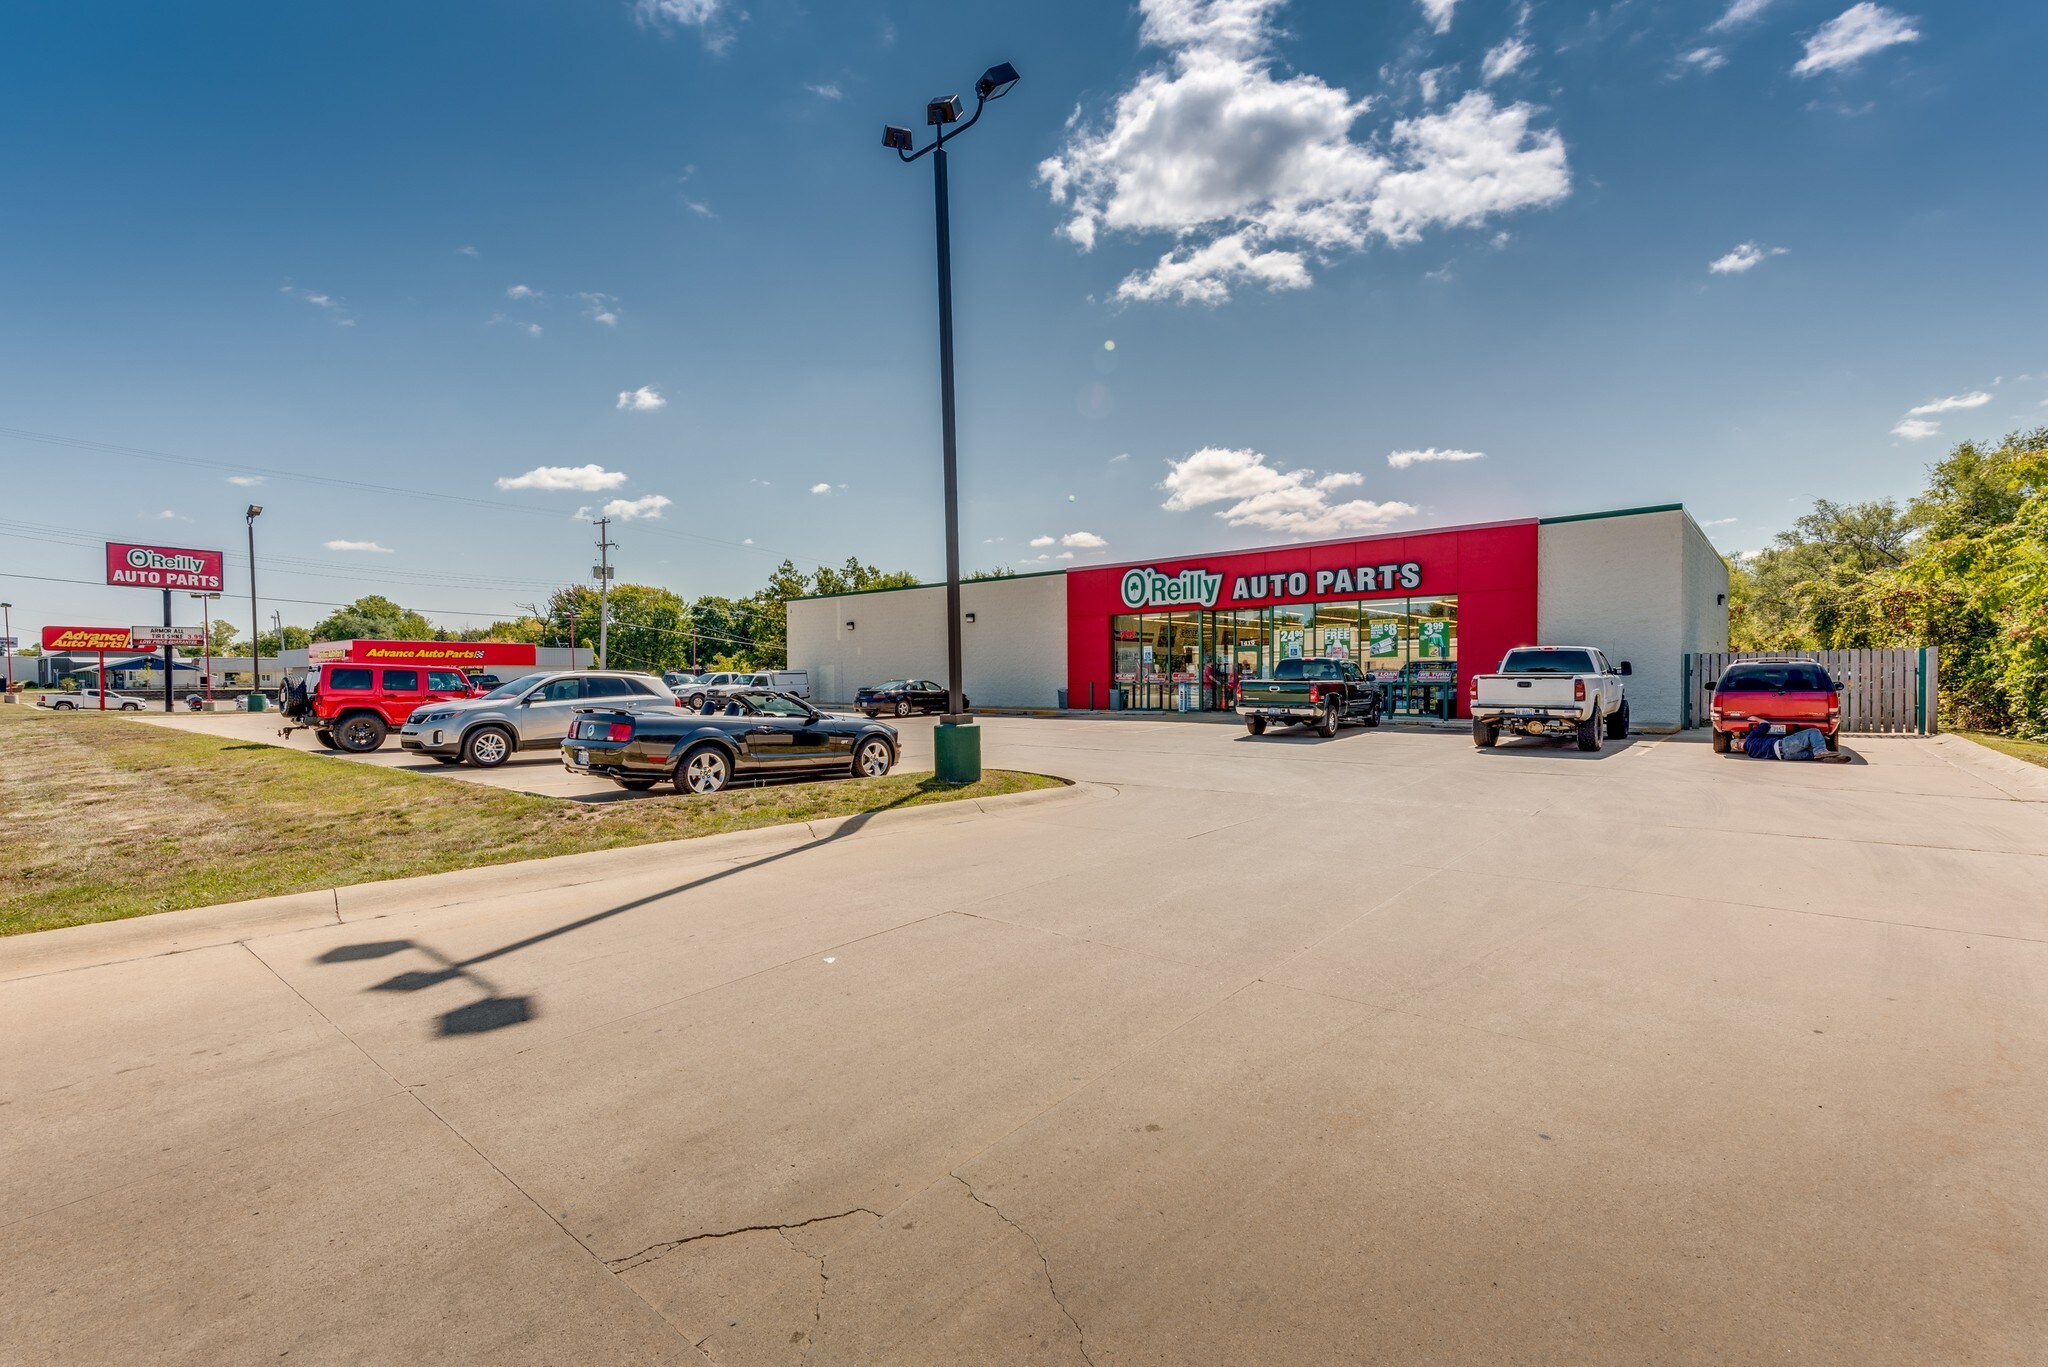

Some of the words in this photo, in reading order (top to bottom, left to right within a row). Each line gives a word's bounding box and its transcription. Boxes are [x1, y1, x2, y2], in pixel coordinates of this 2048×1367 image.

[128, 549, 203, 572] O'Reilly
[113, 570, 160, 583] AUTO
[166, 573, 219, 587] PARTS
[1232, 573, 1308, 600] AUTO
[1316, 562, 1421, 594] PARTS
[1122, 569, 1222, 607] O'Reilly
[58, 631, 126, 642] Advance
[1325, 630, 1350, 640] FREE
[50, 639, 87, 648] Auto
[87, 640, 122, 648] Parts
[366, 649, 414, 658] Advance
[415, 649, 445, 658] Auto
[445, 650, 474, 658] Parts
